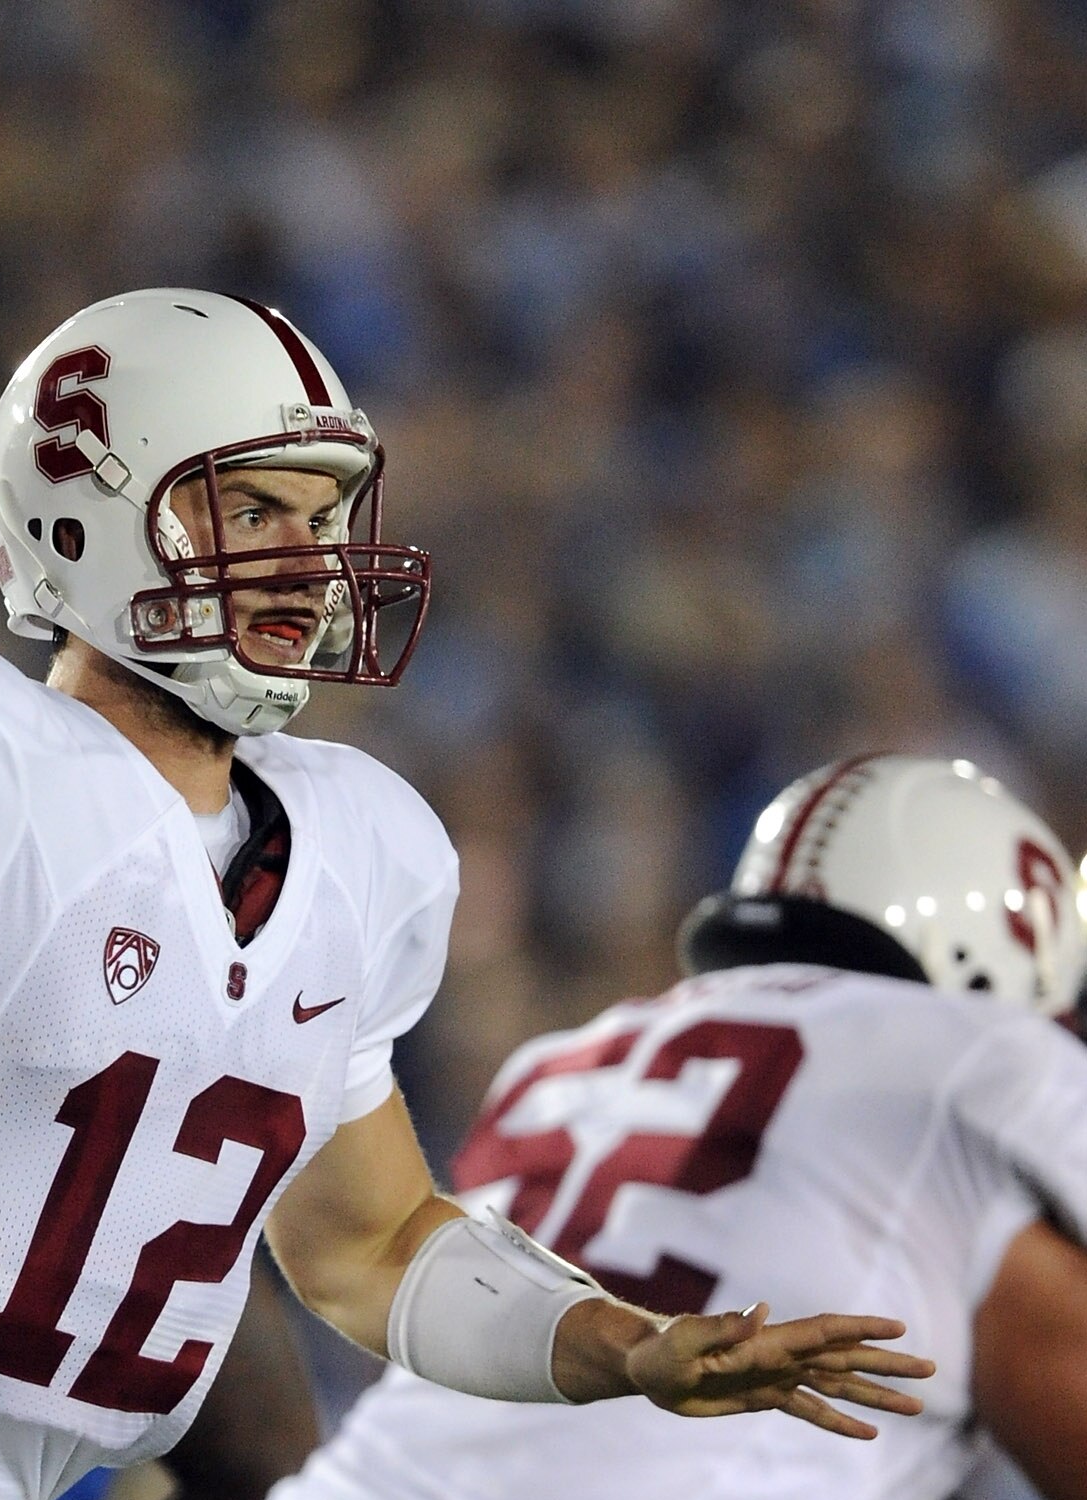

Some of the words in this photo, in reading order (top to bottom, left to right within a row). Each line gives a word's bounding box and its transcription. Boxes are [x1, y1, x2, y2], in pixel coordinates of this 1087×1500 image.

[34, 344, 111, 484] S
[265, 689, 299, 702] Riddell
[108, 931, 157, 981] PAC
[111, 961, 138, 990] 10
[226, 961, 248, 1001] S
